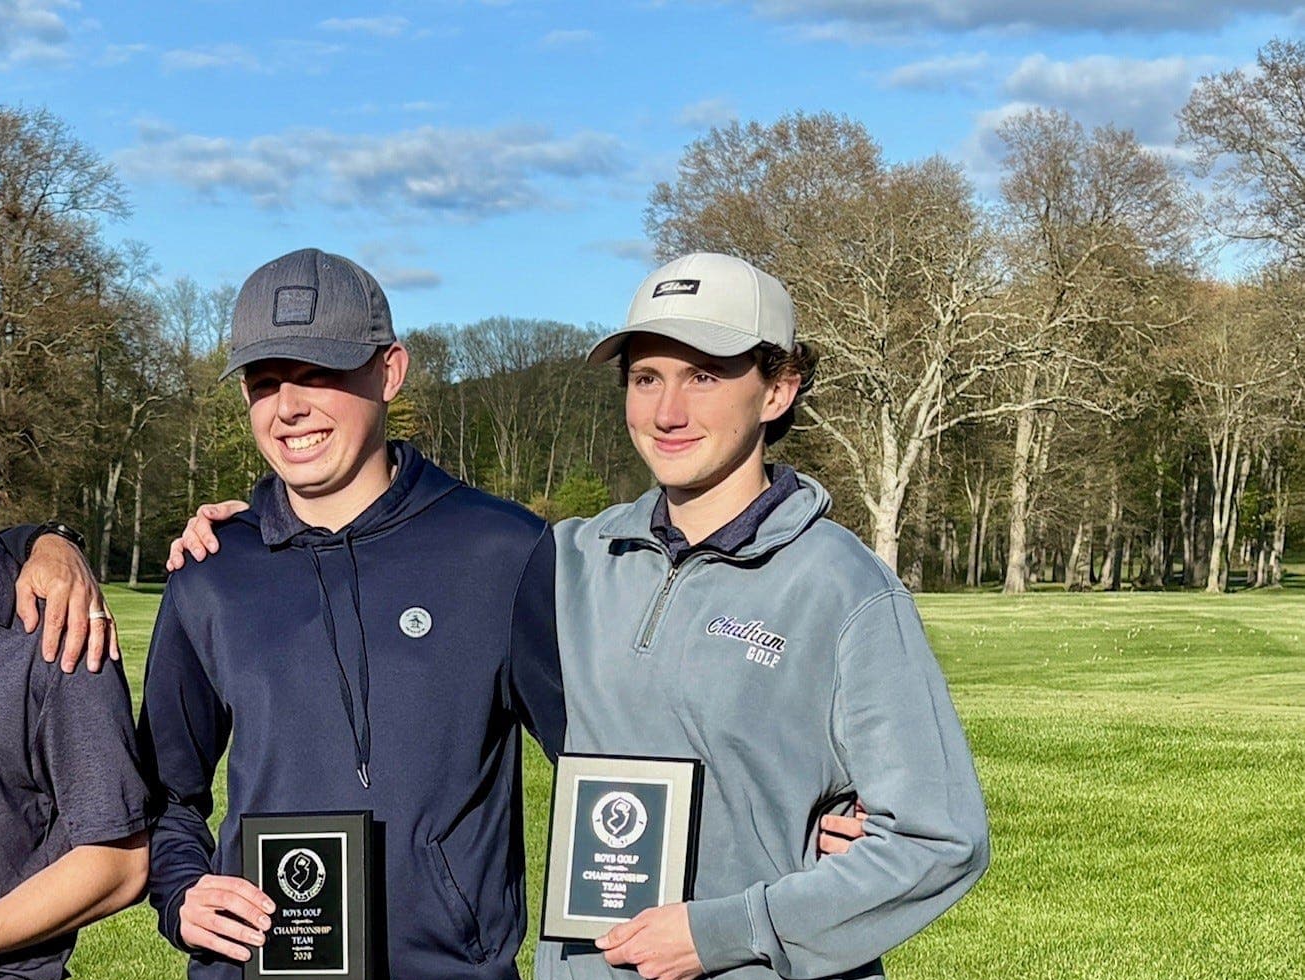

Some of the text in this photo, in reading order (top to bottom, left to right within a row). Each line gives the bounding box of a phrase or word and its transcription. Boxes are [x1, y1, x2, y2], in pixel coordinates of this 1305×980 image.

[706, 615, 787, 653] Chatham
[746, 645, 781, 669] GOLF
[594, 853, 639, 864] BOYS GOLF
[582, 871, 649, 883] CHAMPIONSHIP
[602, 882, 627, 893] TEAM
[282, 908, 322, 917] BOYS GOLF
[273, 926, 332, 935] CHAMPIONSHIP
[291, 936, 313, 944] TEAM
